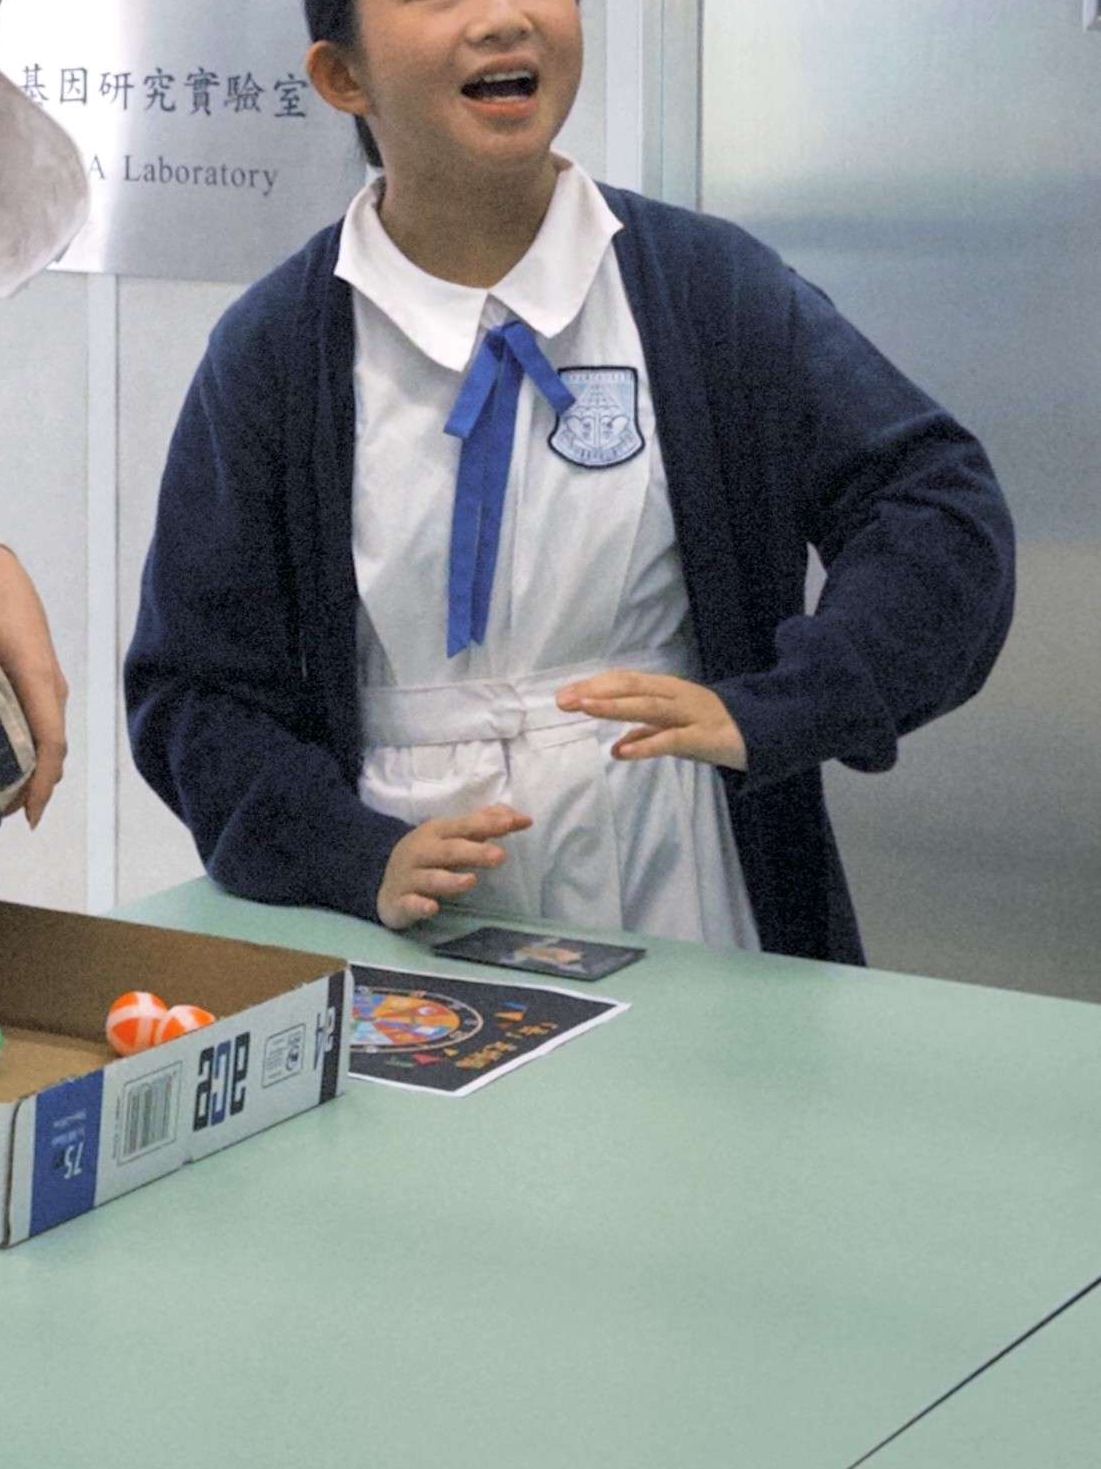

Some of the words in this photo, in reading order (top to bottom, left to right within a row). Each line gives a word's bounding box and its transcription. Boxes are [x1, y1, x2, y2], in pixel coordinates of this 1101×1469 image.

[18, 62, 309, 119] 基因研究實驗室
[123, 154, 279, 196] Laboratory
